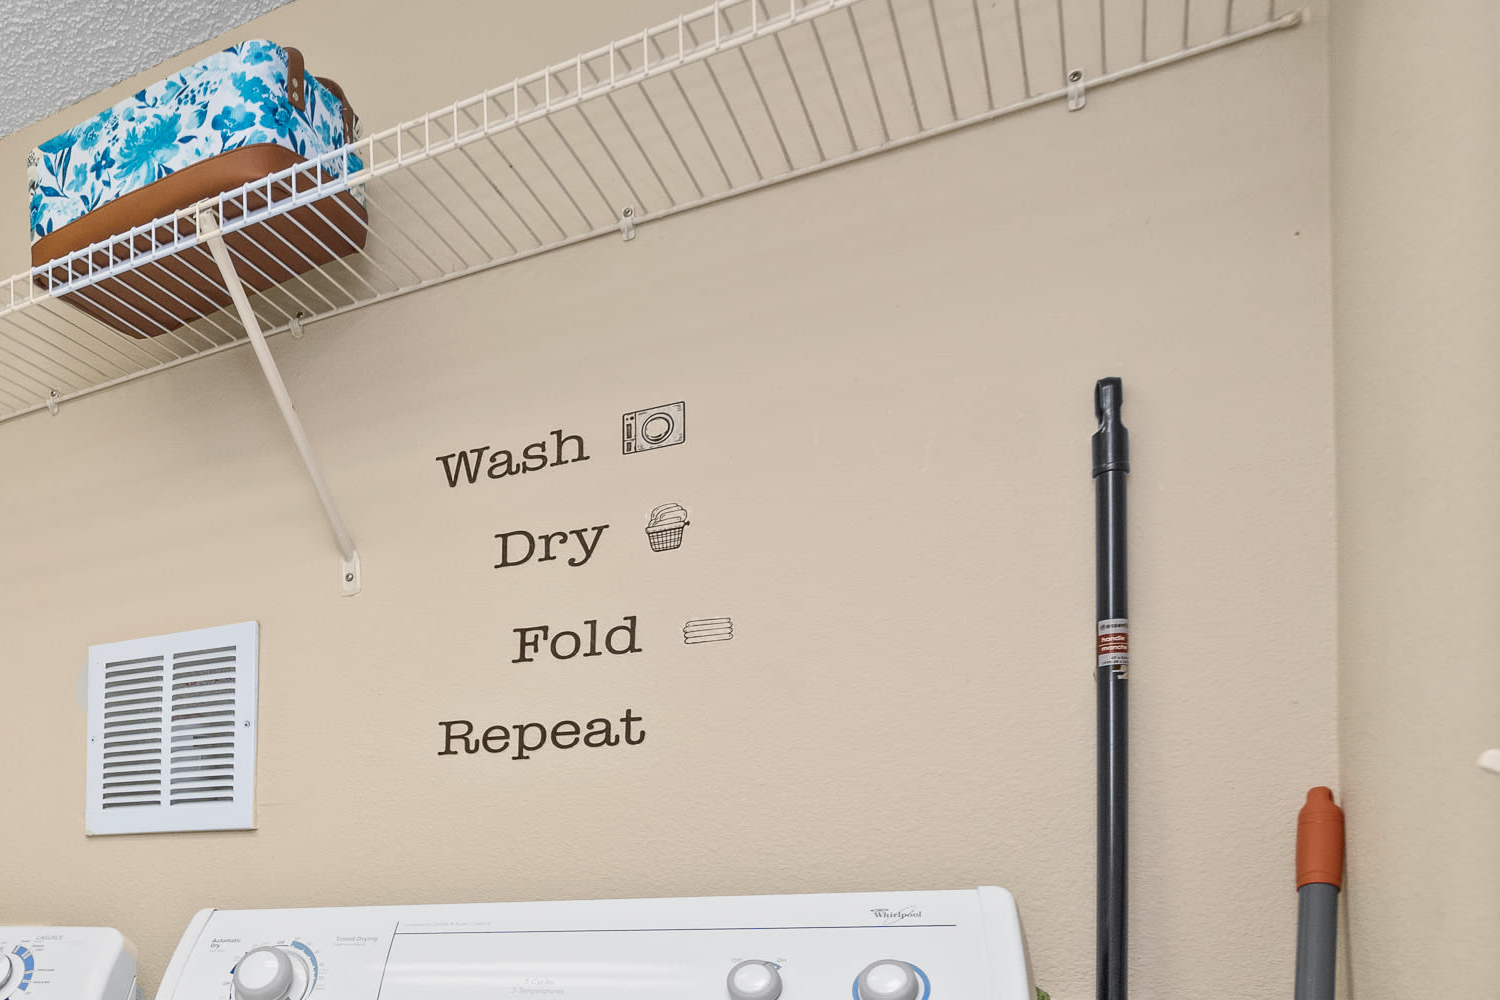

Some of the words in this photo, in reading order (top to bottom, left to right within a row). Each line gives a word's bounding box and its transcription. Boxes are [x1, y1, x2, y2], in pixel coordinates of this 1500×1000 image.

[436, 429, 590, 488] Wash
[494, 524, 609, 568] Dry
[511, 615, 643, 663] Fold
[437, 708, 646, 760] Repeat
[873, 910, 922, 920] Whirlpool
